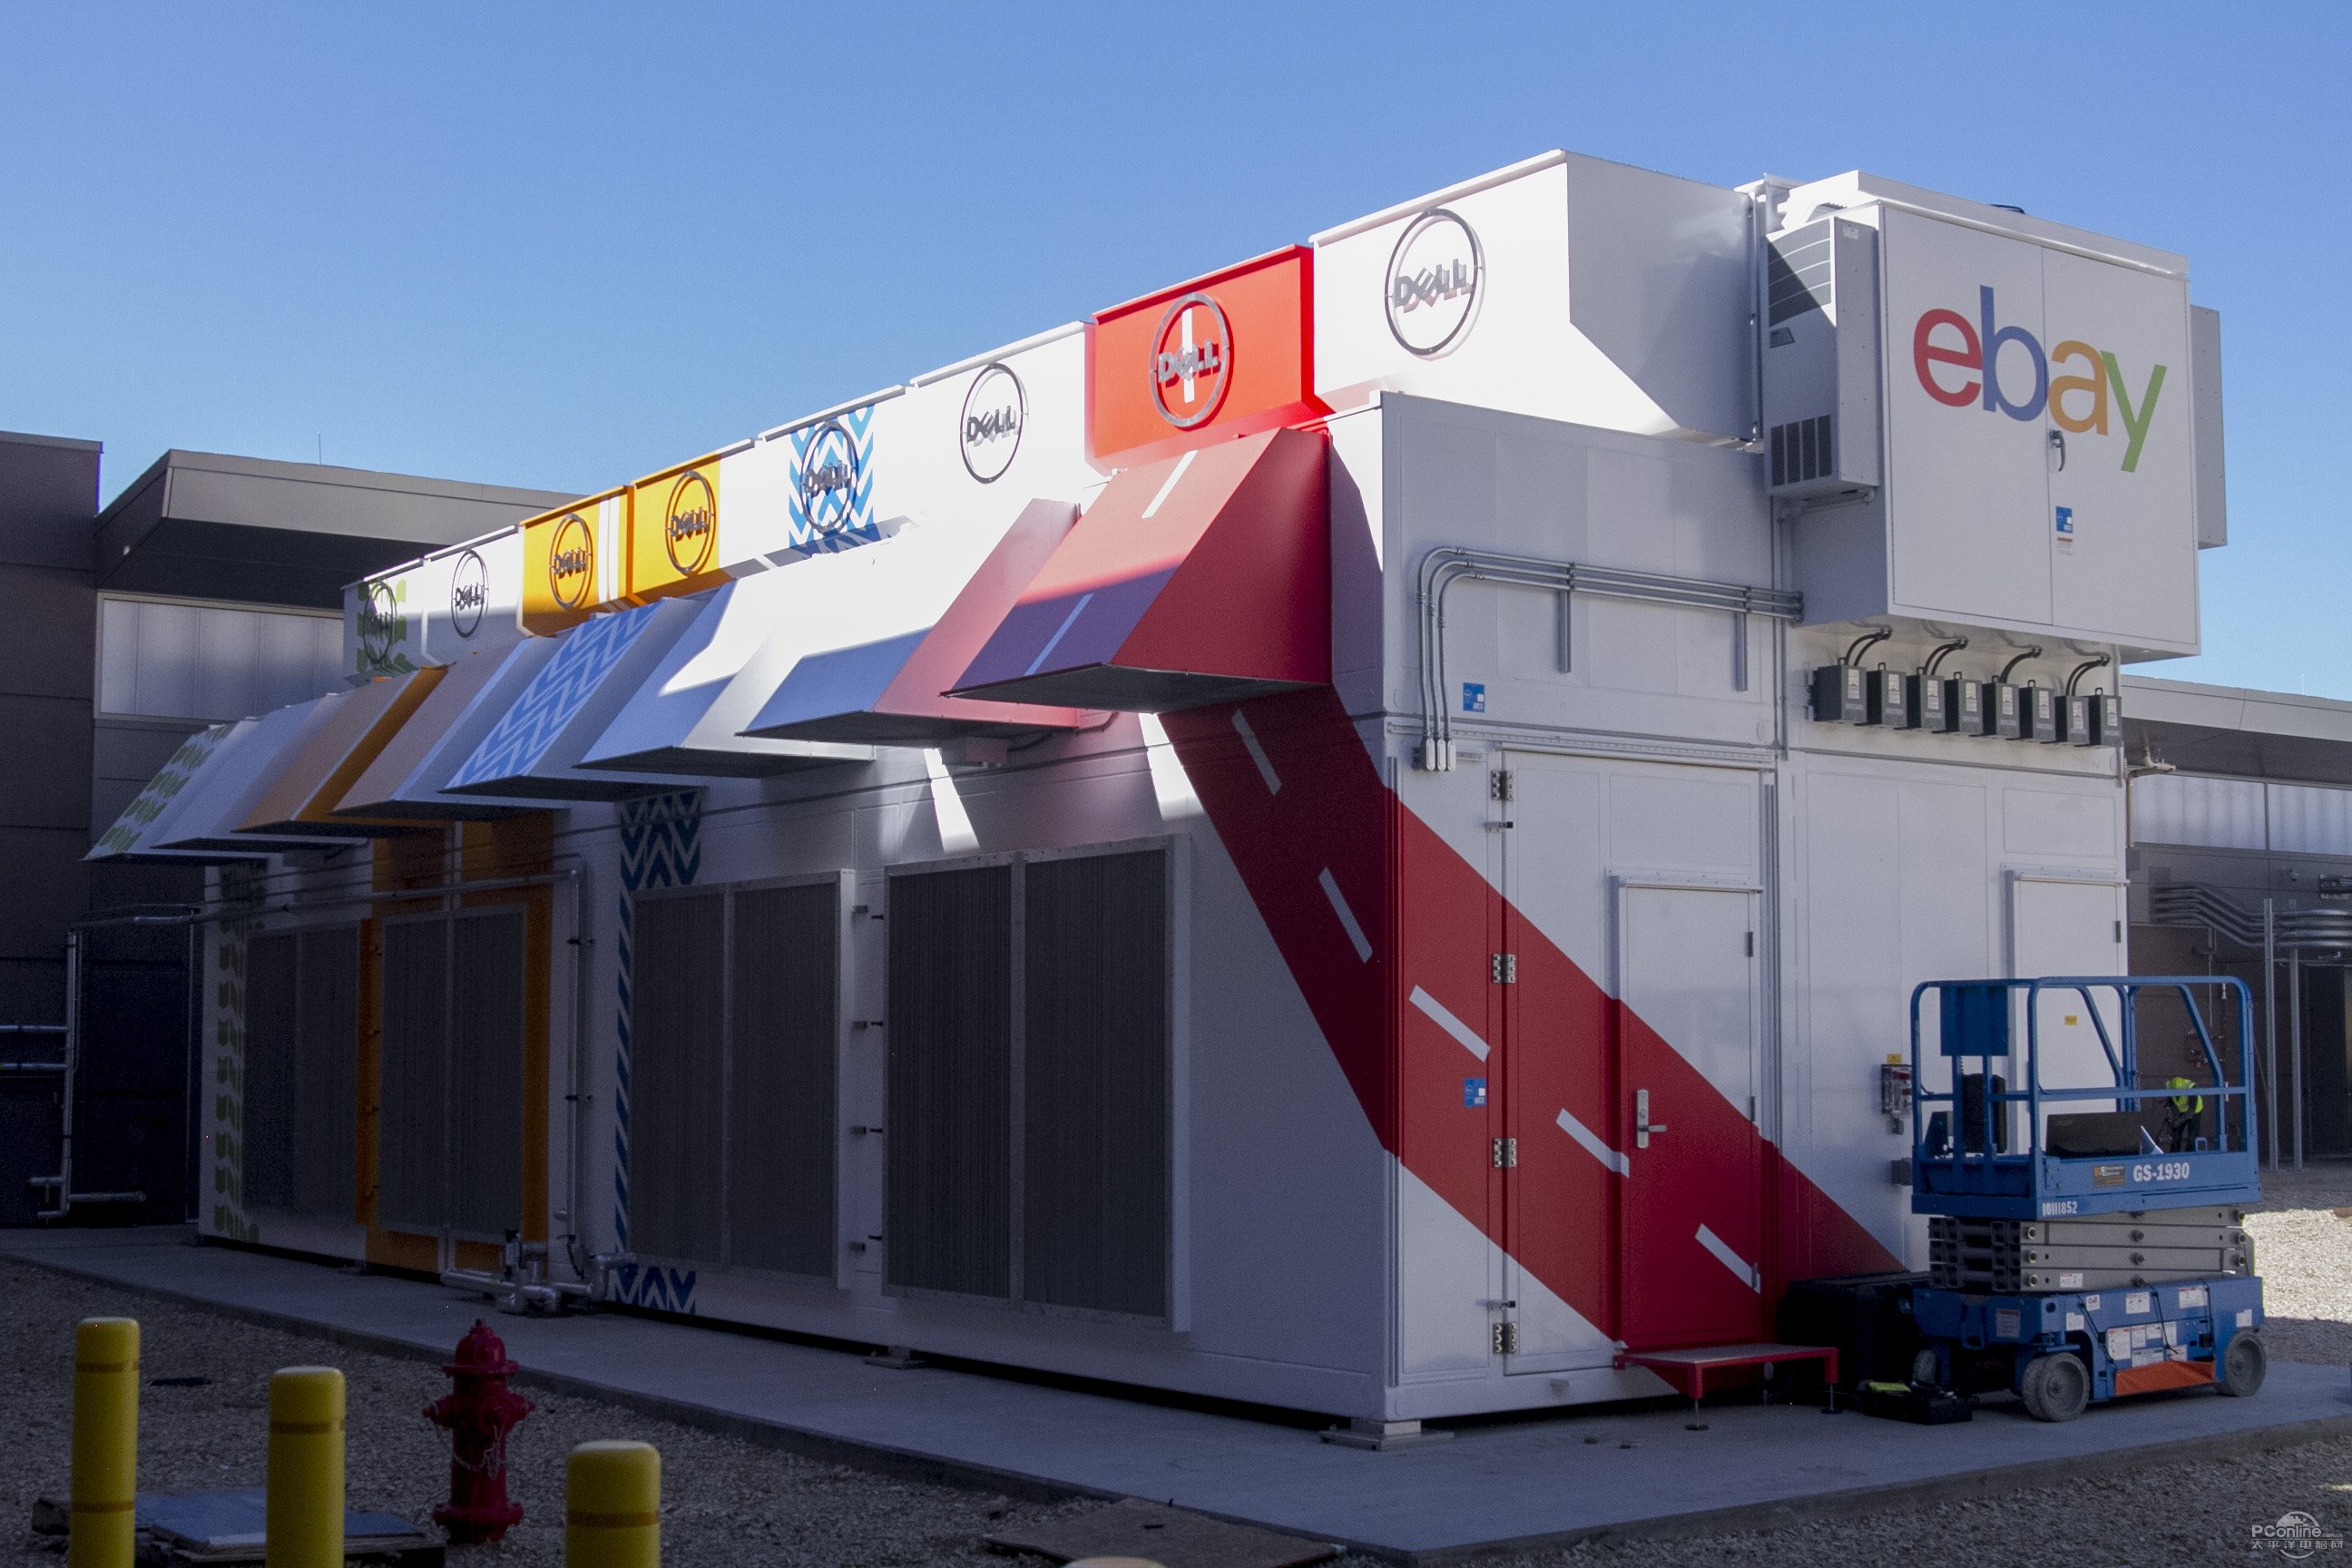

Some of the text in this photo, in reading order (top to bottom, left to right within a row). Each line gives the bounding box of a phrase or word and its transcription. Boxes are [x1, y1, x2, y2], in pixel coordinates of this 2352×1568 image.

[1395, 259, 1467, 307] DELL
[1158, 338, 1218, 383] DELL
[1913, 285, 2167, 473] ebay
[967, 405, 1016, 443] DELL
[805, 460, 849, 494] DELL
[670, 507, 706, 537] DELL
[554, 547, 586, 574] DELL
[456, 582, 485, 607] DELL
[2133, 1162, 2190, 1181] GS-1930
